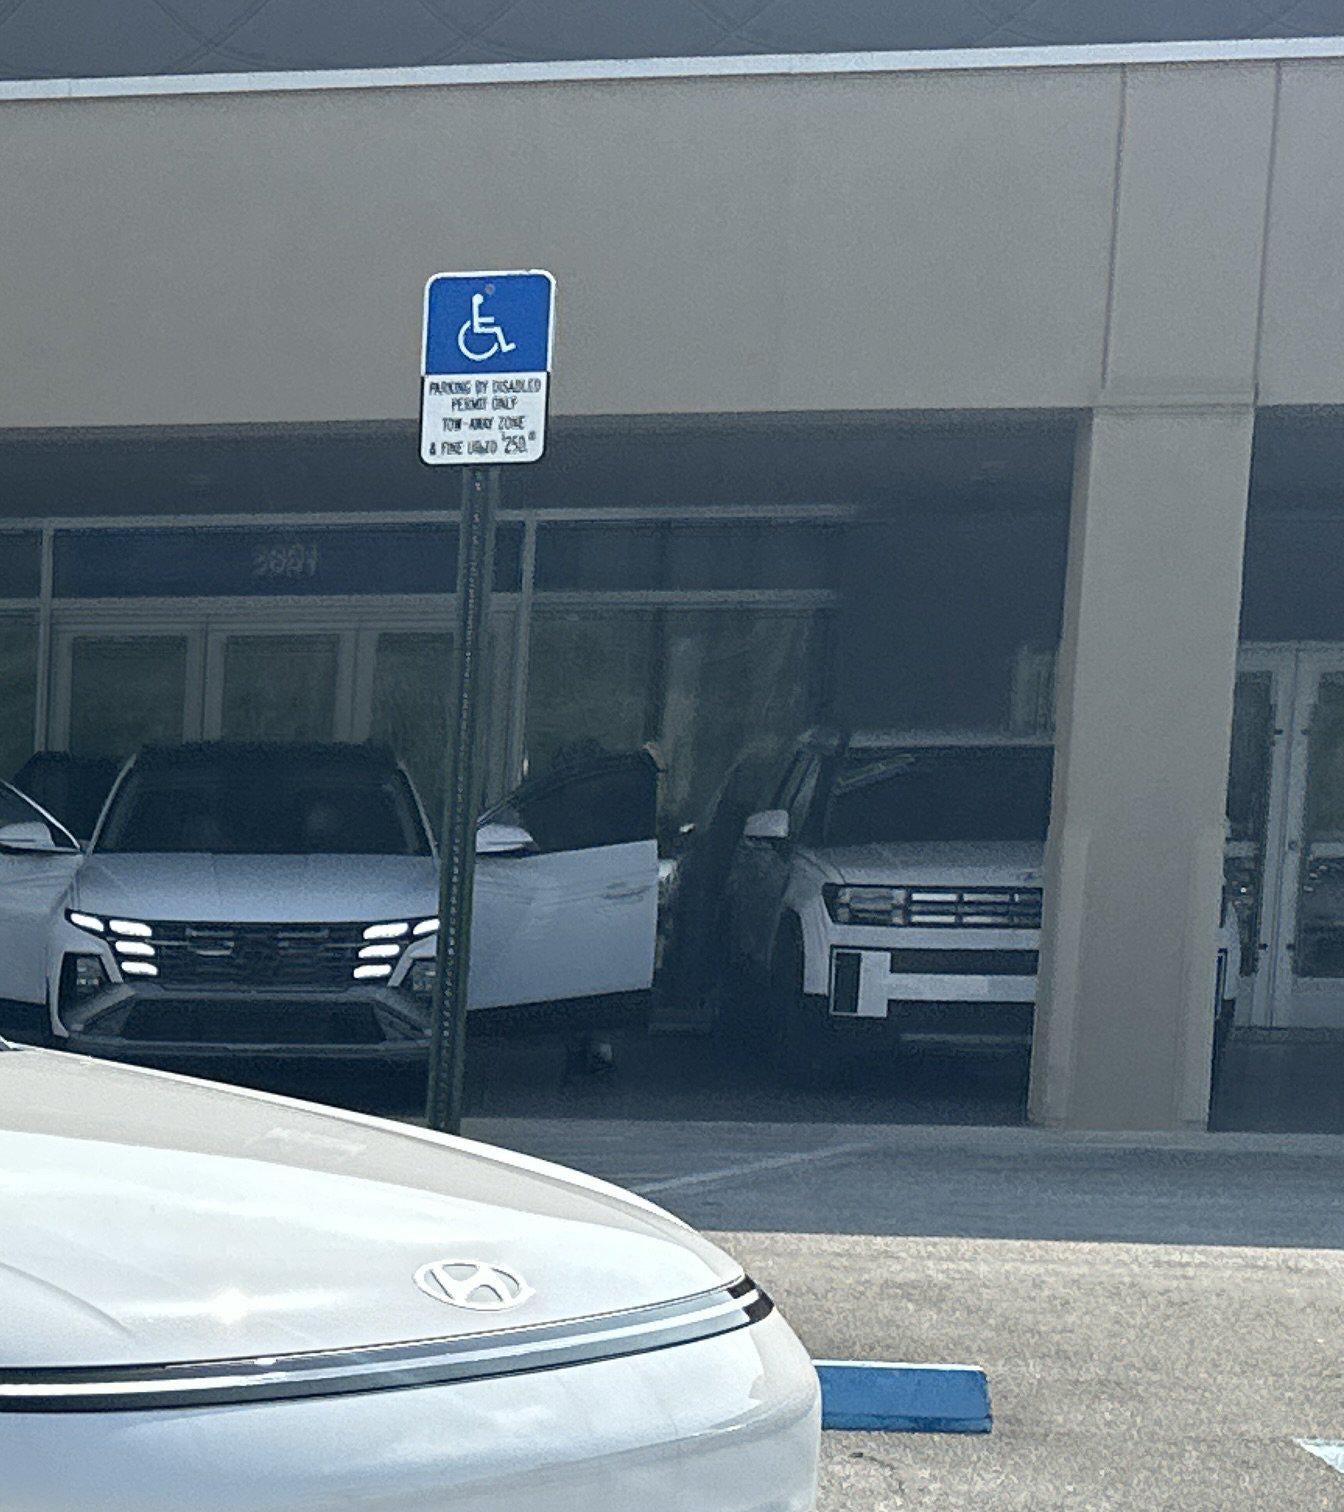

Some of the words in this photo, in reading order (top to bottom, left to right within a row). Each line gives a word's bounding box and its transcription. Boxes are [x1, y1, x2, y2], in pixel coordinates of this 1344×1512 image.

[428, 380, 472, 395] PARKING
[475, 380, 488, 395] BY
[492, 378, 542, 393] DISABLED
[451, 397, 487, 412] PERMIT
[491, 396, 519, 411] ONLY
[441, 417, 494, 431] TOW-AWAY
[498, 415, 526, 430] ZONE
